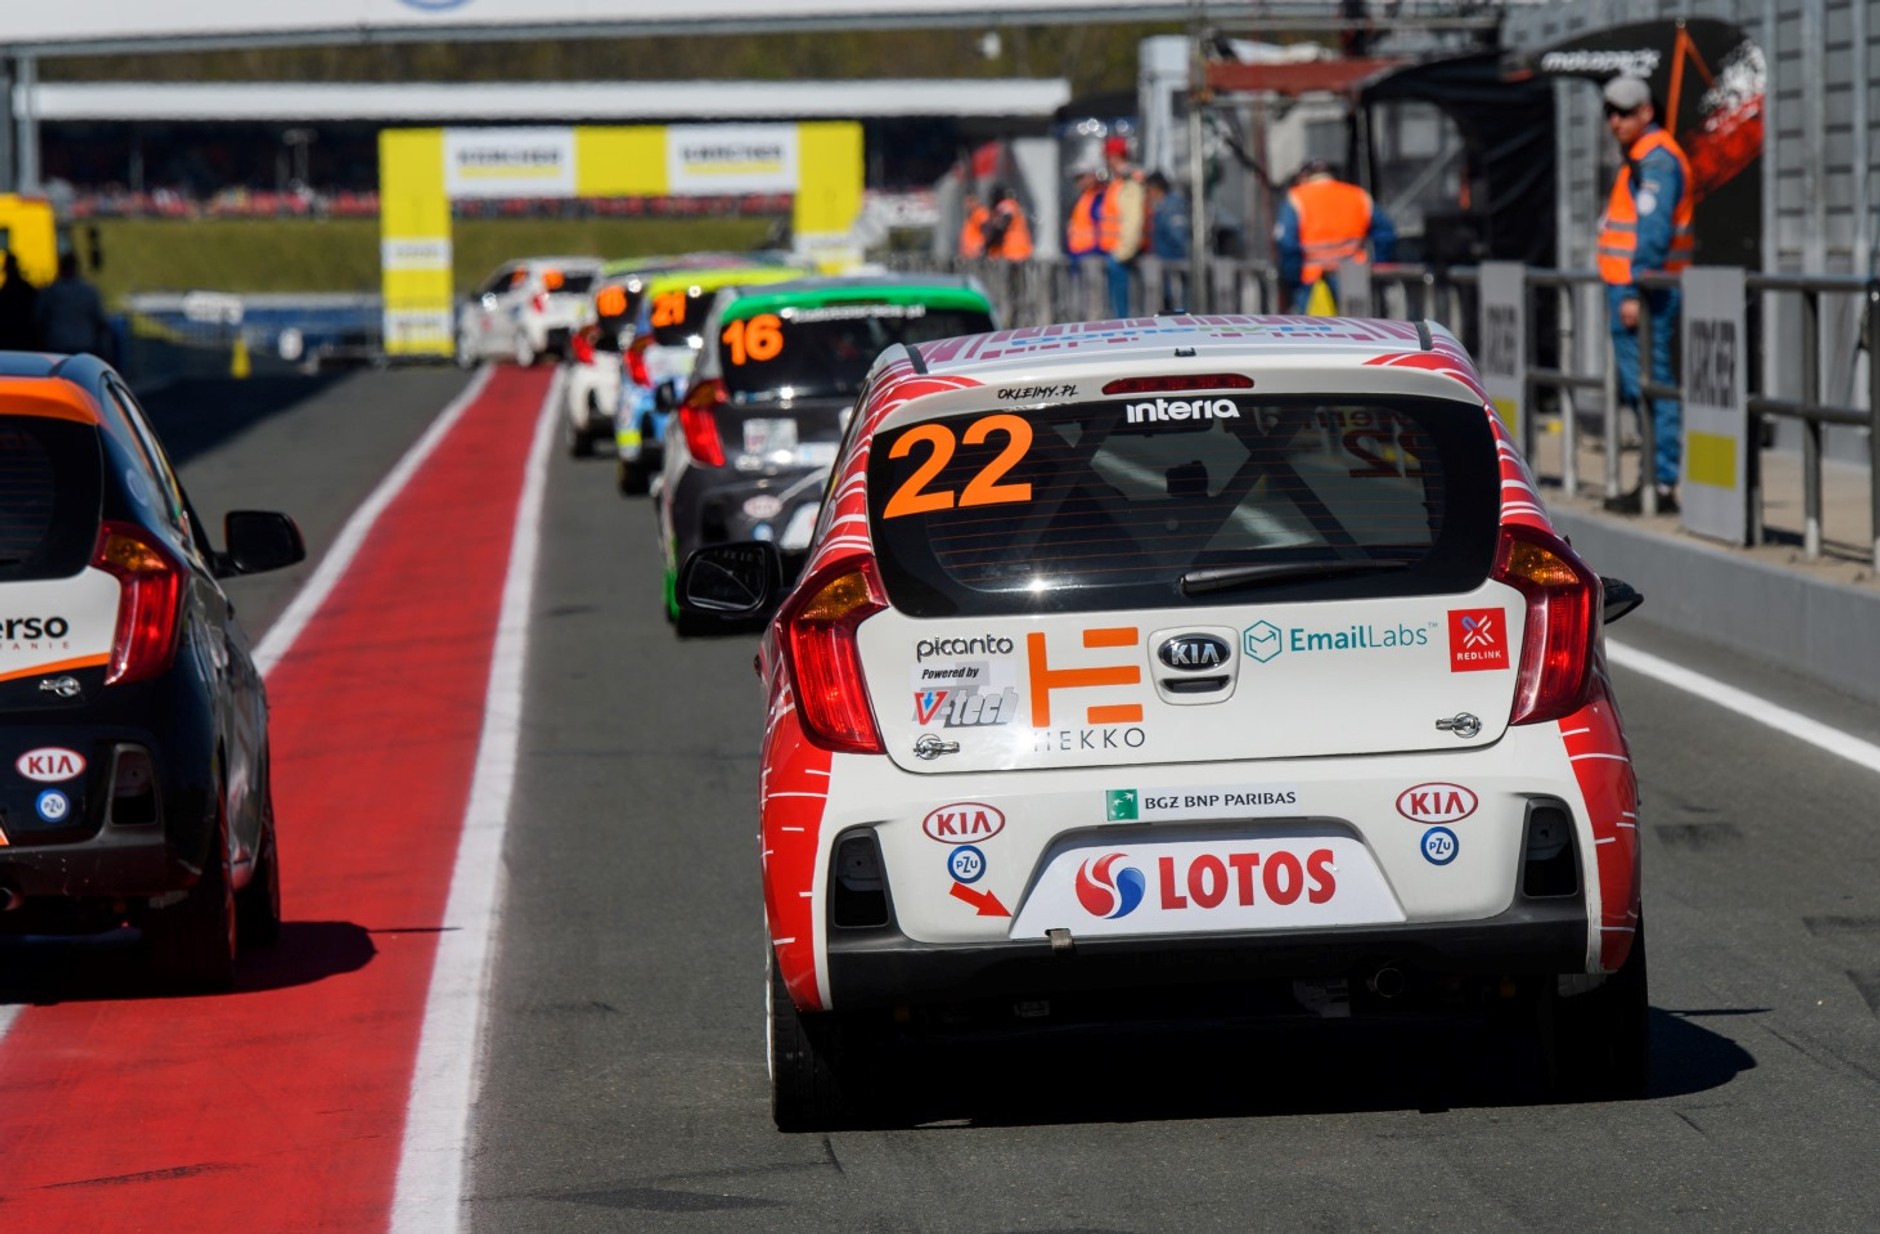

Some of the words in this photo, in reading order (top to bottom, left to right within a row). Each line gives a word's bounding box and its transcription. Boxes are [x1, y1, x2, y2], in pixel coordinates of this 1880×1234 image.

[722, 313, 785, 365] 16
[1126, 398, 1240, 424] interia
[883, 414, 1034, 519] 22
[0, 616, 69, 640] rso
[0, 641, 70, 650] ANIE
[916, 634, 1014, 663] picanto
[1172, 643, 1220, 665] KIA
[1456, 649, 1502, 661] REDLINK
[922, 668, 965, 680] Powered
[966, 667, 979, 678] by
[27, 755, 74, 774] KIA
[1185, 795, 1219, 807] BNP
[1225, 791, 1296, 806] PARIBAS
[1410, 792, 1465, 815] KIA
[937, 811, 992, 836] KIA
[1430, 838, 1450, 854] PZU
[956, 856, 978, 873] PZU
[1158, 849, 1336, 910] LOTOS
